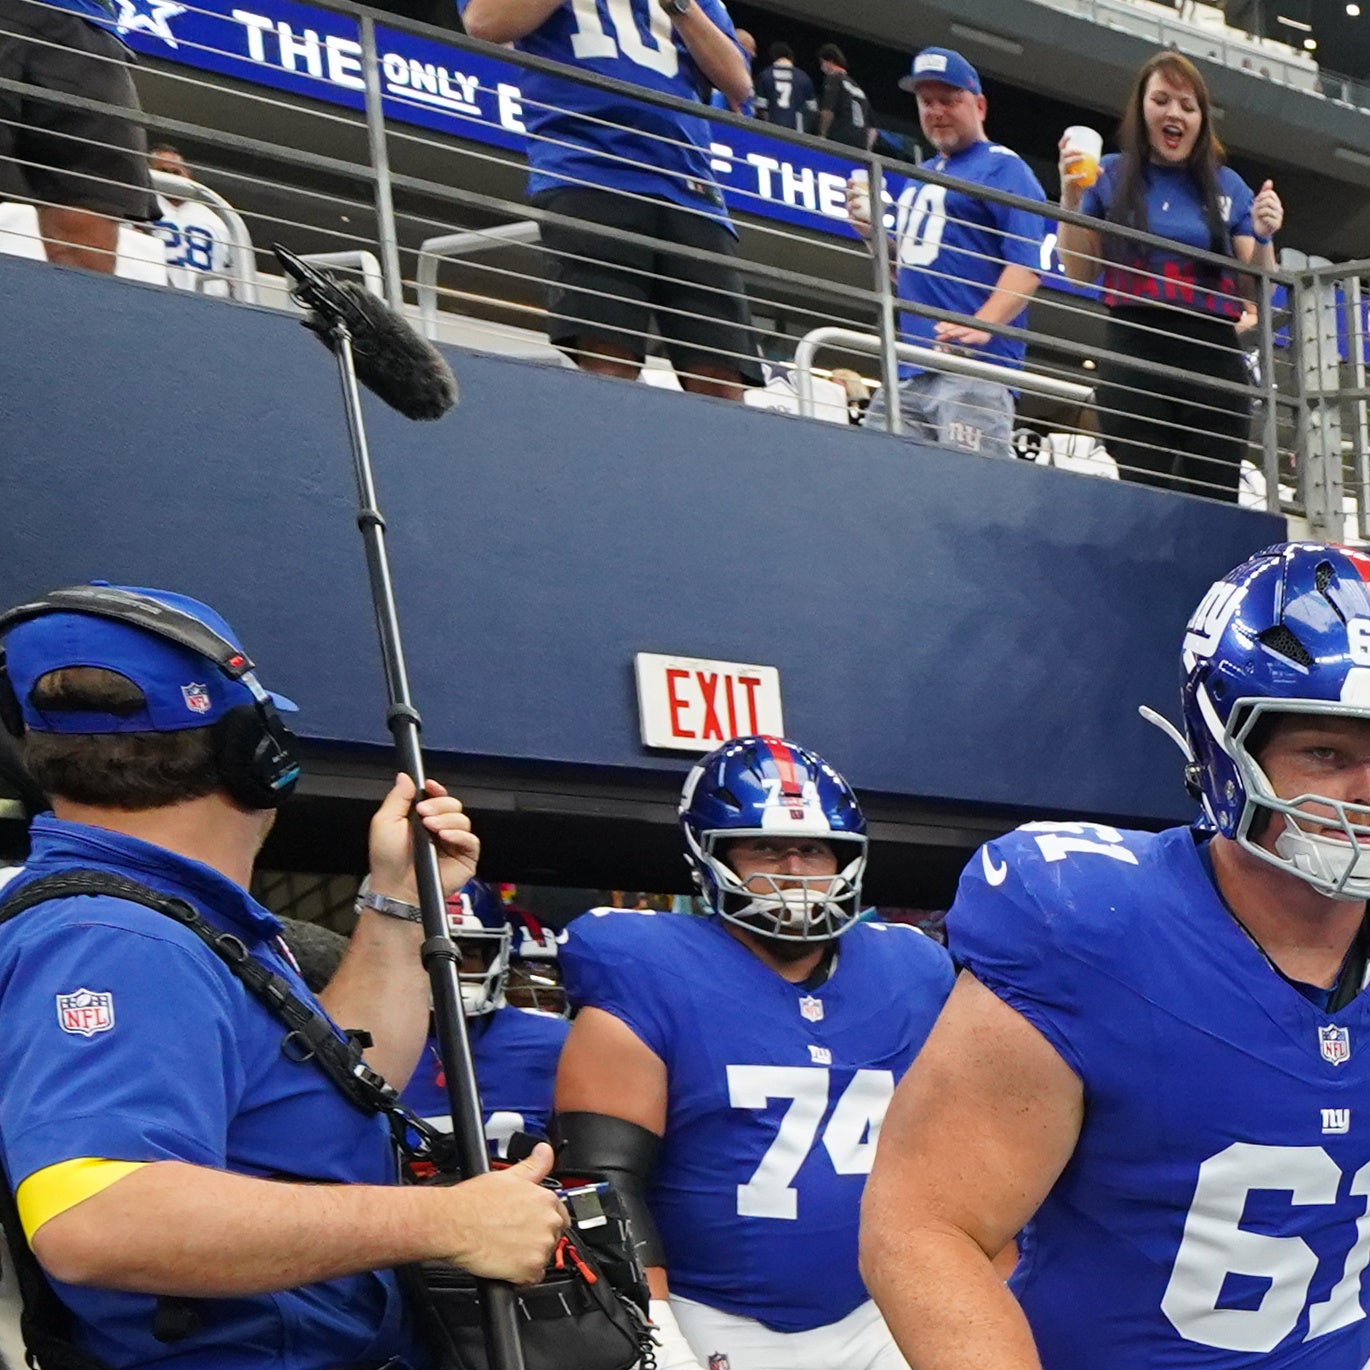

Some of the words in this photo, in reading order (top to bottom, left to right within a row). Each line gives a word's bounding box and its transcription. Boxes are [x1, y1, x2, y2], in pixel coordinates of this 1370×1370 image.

[233, 9, 365, 89] THE
[383, 53, 480, 104] ONLY
[747, 153, 849, 219] THE
[666, 668, 761, 742] EXIT
[65, 1007, 107, 1029] NFL
[725, 1064, 895, 1220] 74
